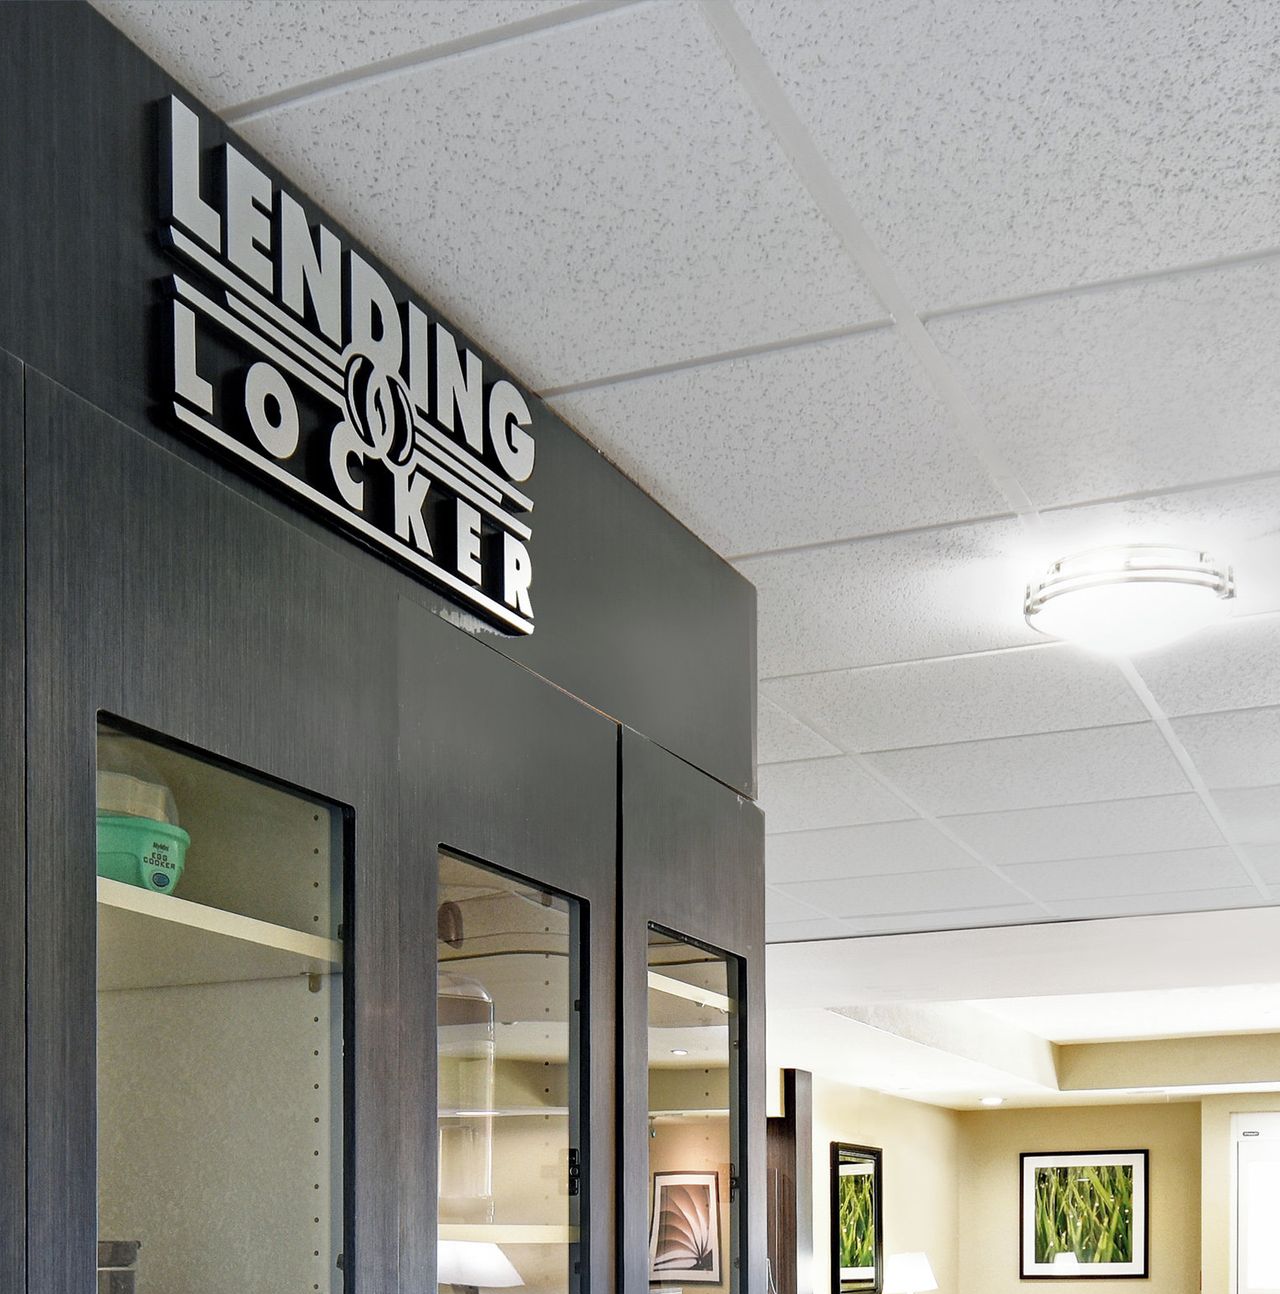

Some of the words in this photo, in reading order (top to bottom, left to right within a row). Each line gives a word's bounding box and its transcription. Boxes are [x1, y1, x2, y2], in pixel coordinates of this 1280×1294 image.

[171, 94, 535, 482] LENDING
[174, 299, 535, 618] LOCKER
[143, 856, 176, 870] COOKER
